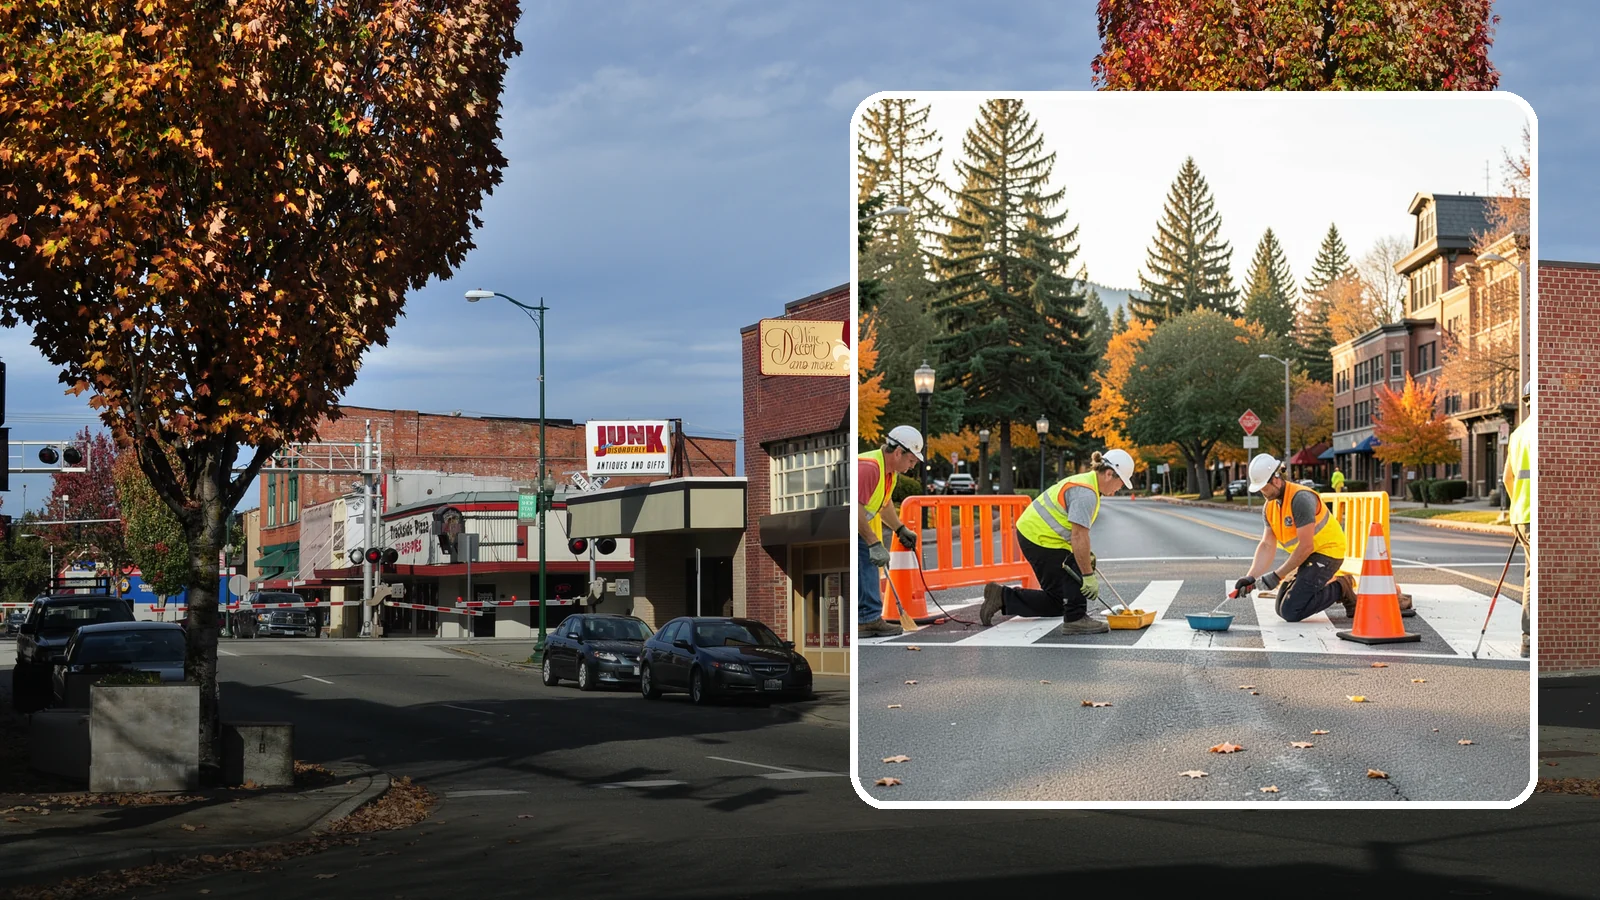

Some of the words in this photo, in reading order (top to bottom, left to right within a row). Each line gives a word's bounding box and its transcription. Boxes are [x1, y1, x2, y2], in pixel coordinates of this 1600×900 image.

[595, 425, 665, 457] JUNK
[607, 446, 646, 454] DISORDERLY
[597, 460, 628, 470] ANTIQUES
[631, 460, 644, 470] AND
[646, 460, 665, 469] GIFTS
[414, 519, 429, 535] Pizza
